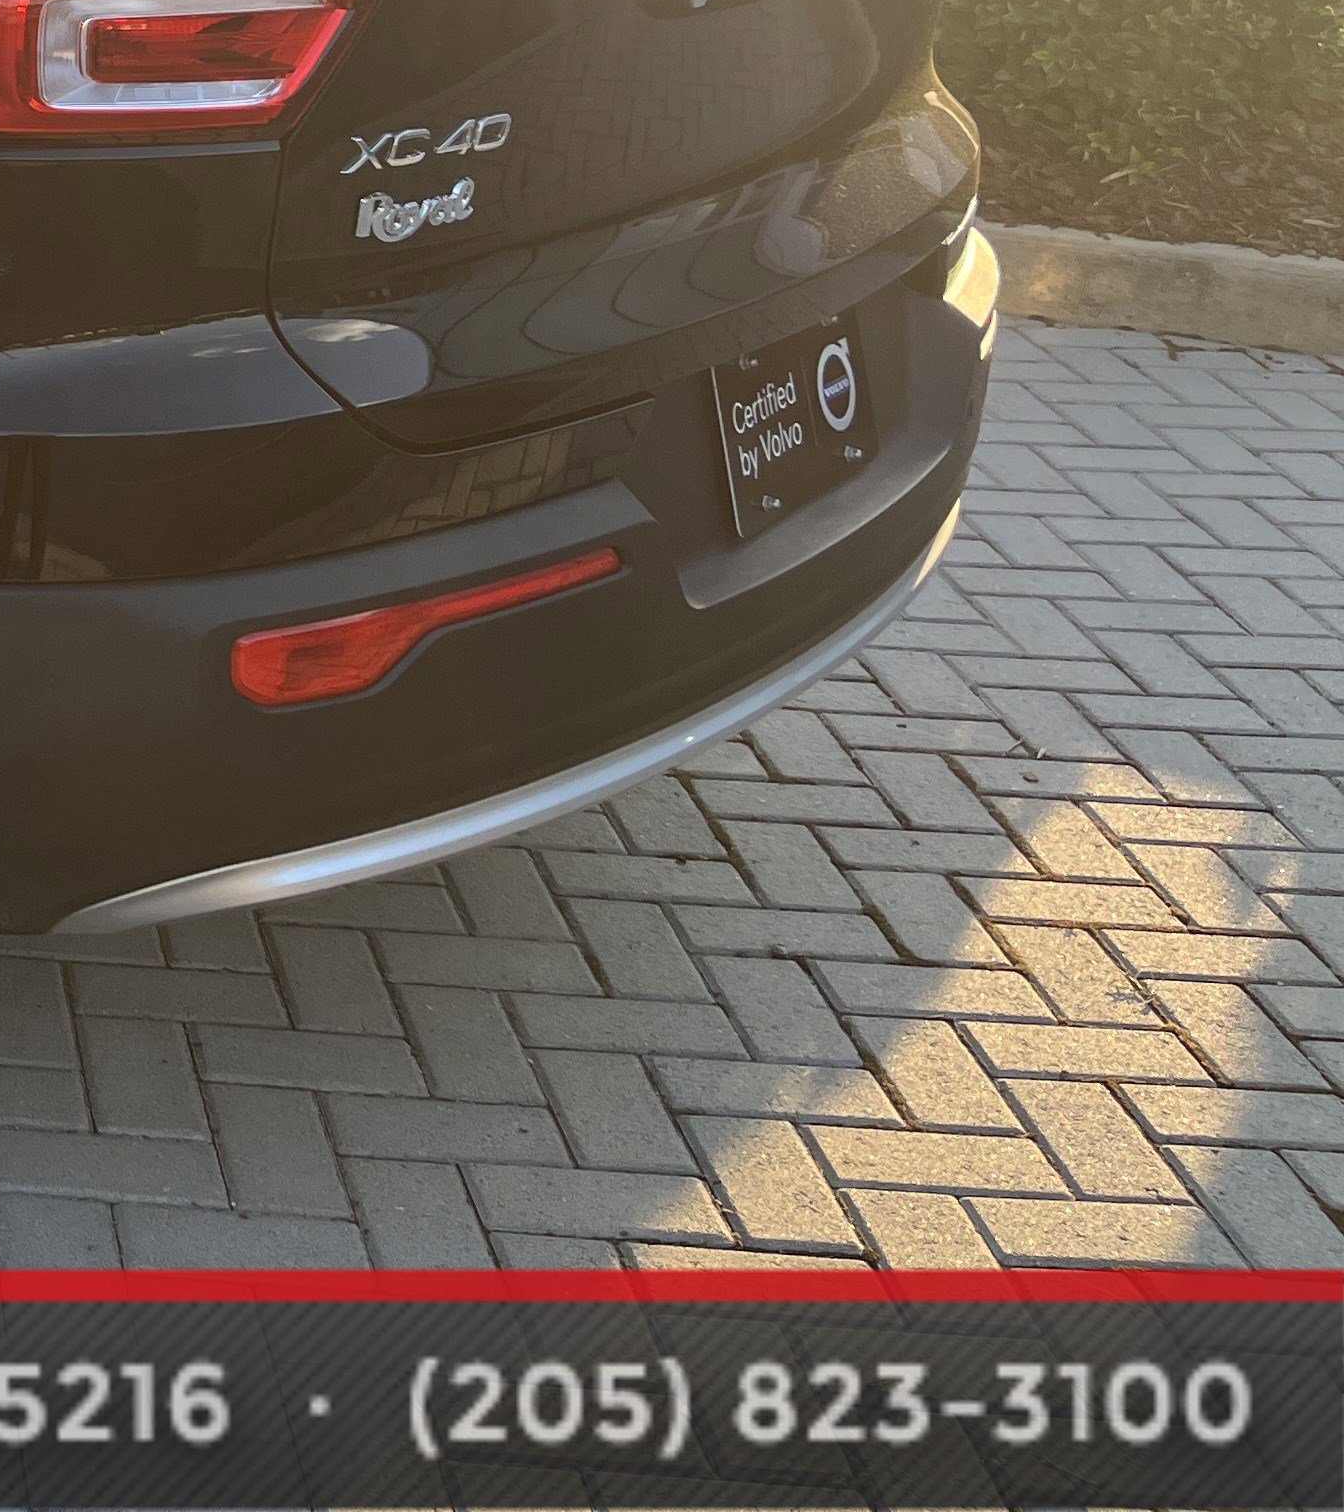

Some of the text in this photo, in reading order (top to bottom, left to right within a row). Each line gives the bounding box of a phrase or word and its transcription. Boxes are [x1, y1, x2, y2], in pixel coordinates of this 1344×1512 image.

[355, 176, 475, 243] Royal
[732, 371, 797, 434] Certified
[738, 421, 803, 480] by Volvo
